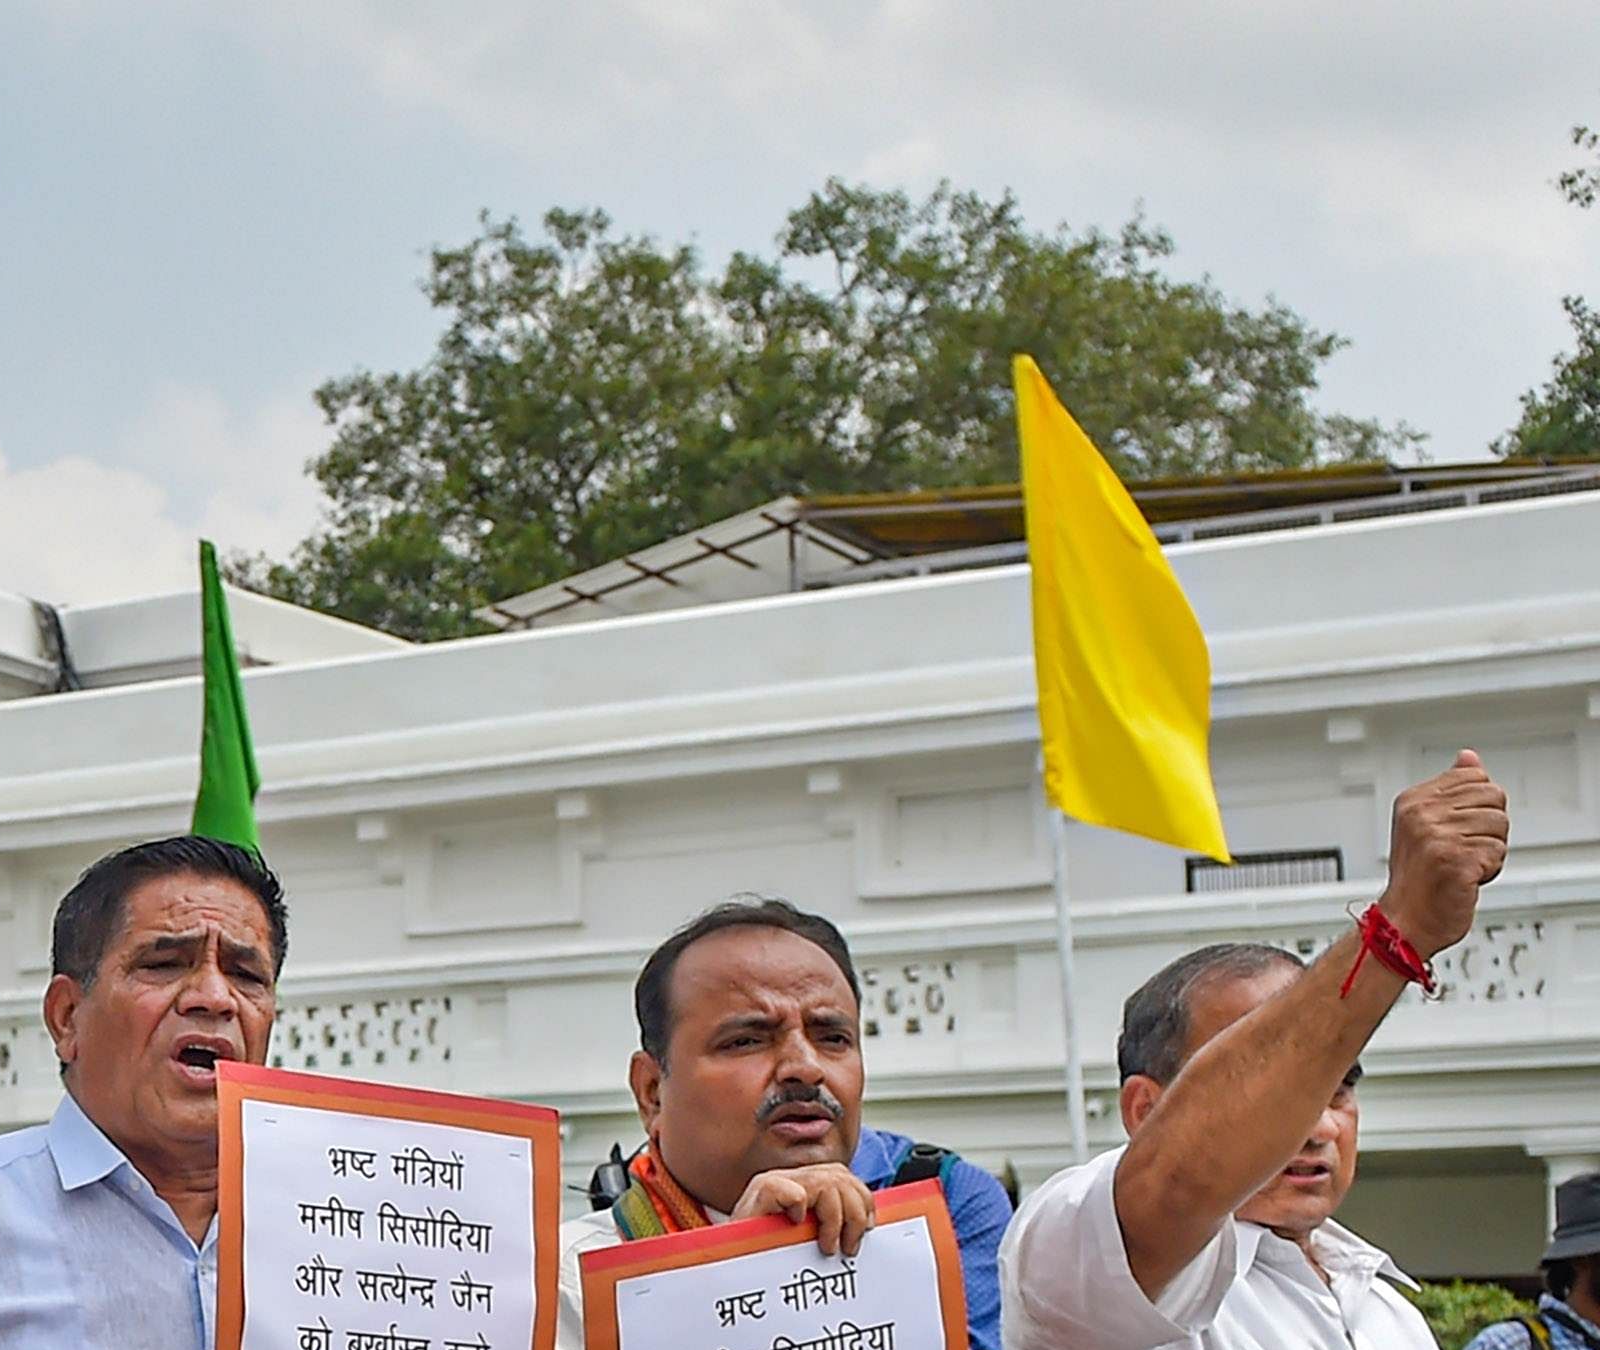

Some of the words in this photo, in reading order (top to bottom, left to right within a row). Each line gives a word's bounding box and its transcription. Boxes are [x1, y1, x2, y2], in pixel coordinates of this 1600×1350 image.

[328, 1148, 377, 1179] भ्रष्ट
[390, 1147, 464, 1191] मंत्रियों
[298, 1196, 365, 1239] मनीष
[377, 1202, 493, 1254] सिसोदिया
[295, 1254, 343, 1297] और
[355, 1263, 437, 1309] सत्येन्द्र
[450, 1270, 493, 1314] जैन
[715, 1290, 767, 1328] भ्रष्ट
[779, 1260, 861, 1312] मंत्रियों
